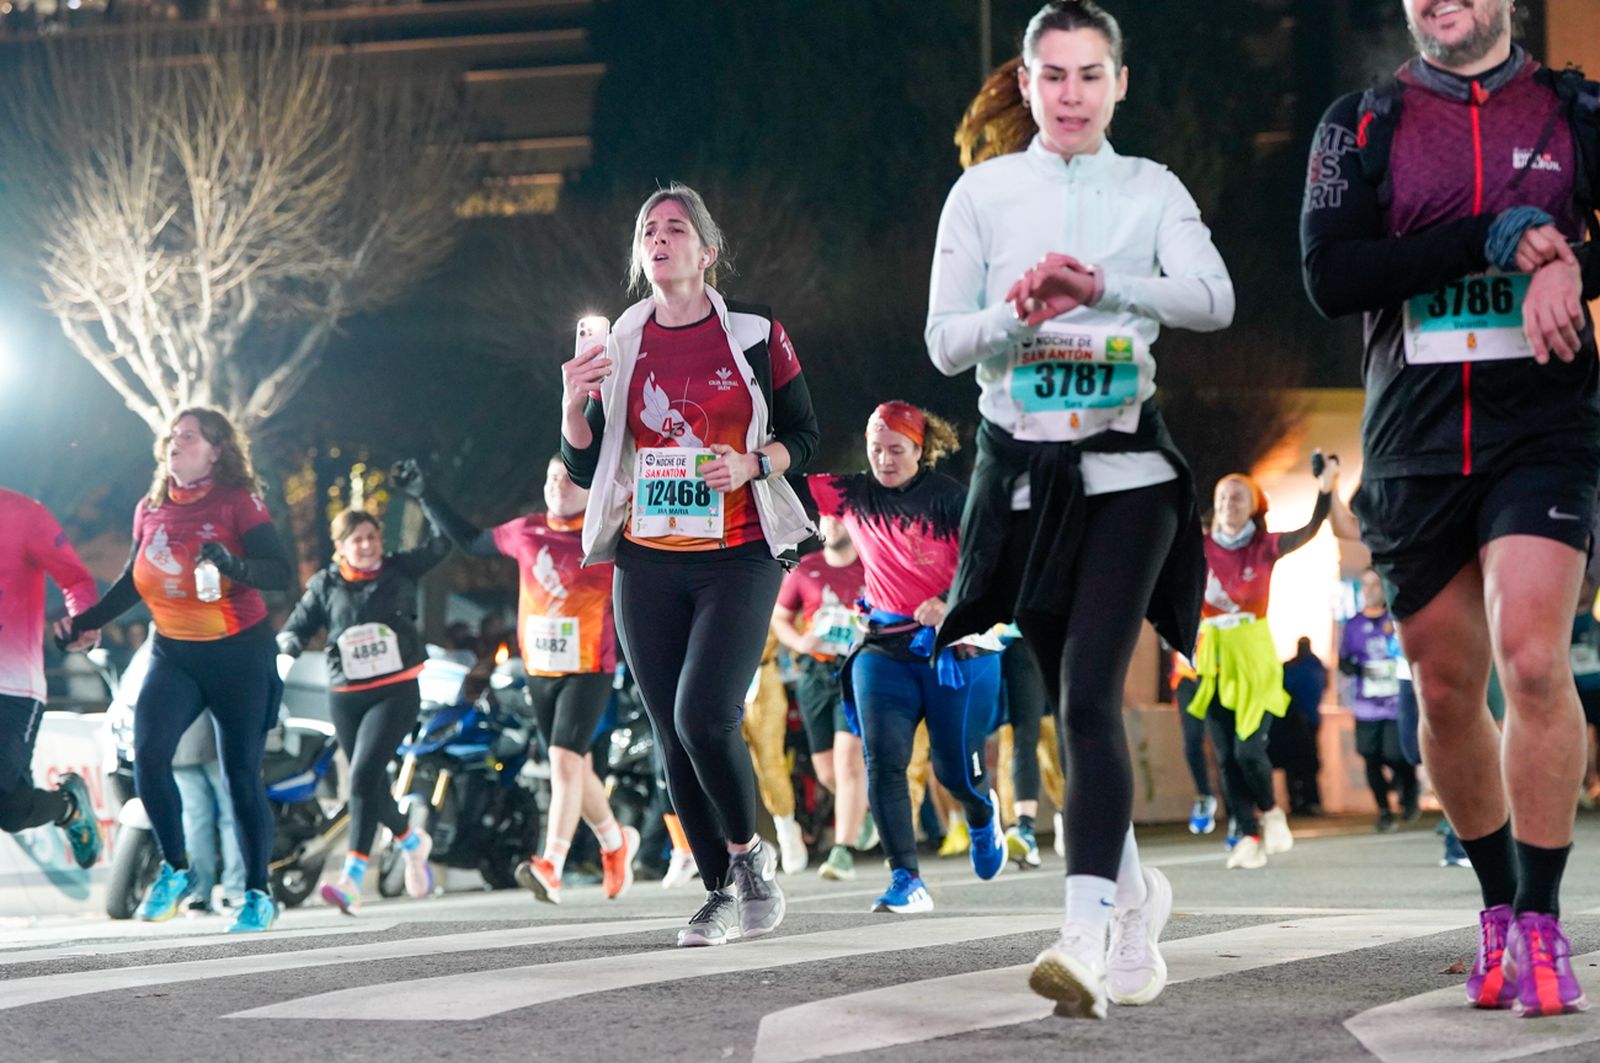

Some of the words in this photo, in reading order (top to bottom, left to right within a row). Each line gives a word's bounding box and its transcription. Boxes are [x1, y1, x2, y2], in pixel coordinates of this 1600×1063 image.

[1427, 278, 1514, 318] 3786
[1036, 337, 1073, 347] NOCHE
[1078, 338, 1092, 347] DE
[1035, 362, 1114, 398] 3787
[662, 417, 686, 437] 43
[656, 458, 675, 467] NOCHE
[677, 458, 687, 466] DE
[645, 480, 711, 507] 12468
[353, 640, 388, 660] 4883
